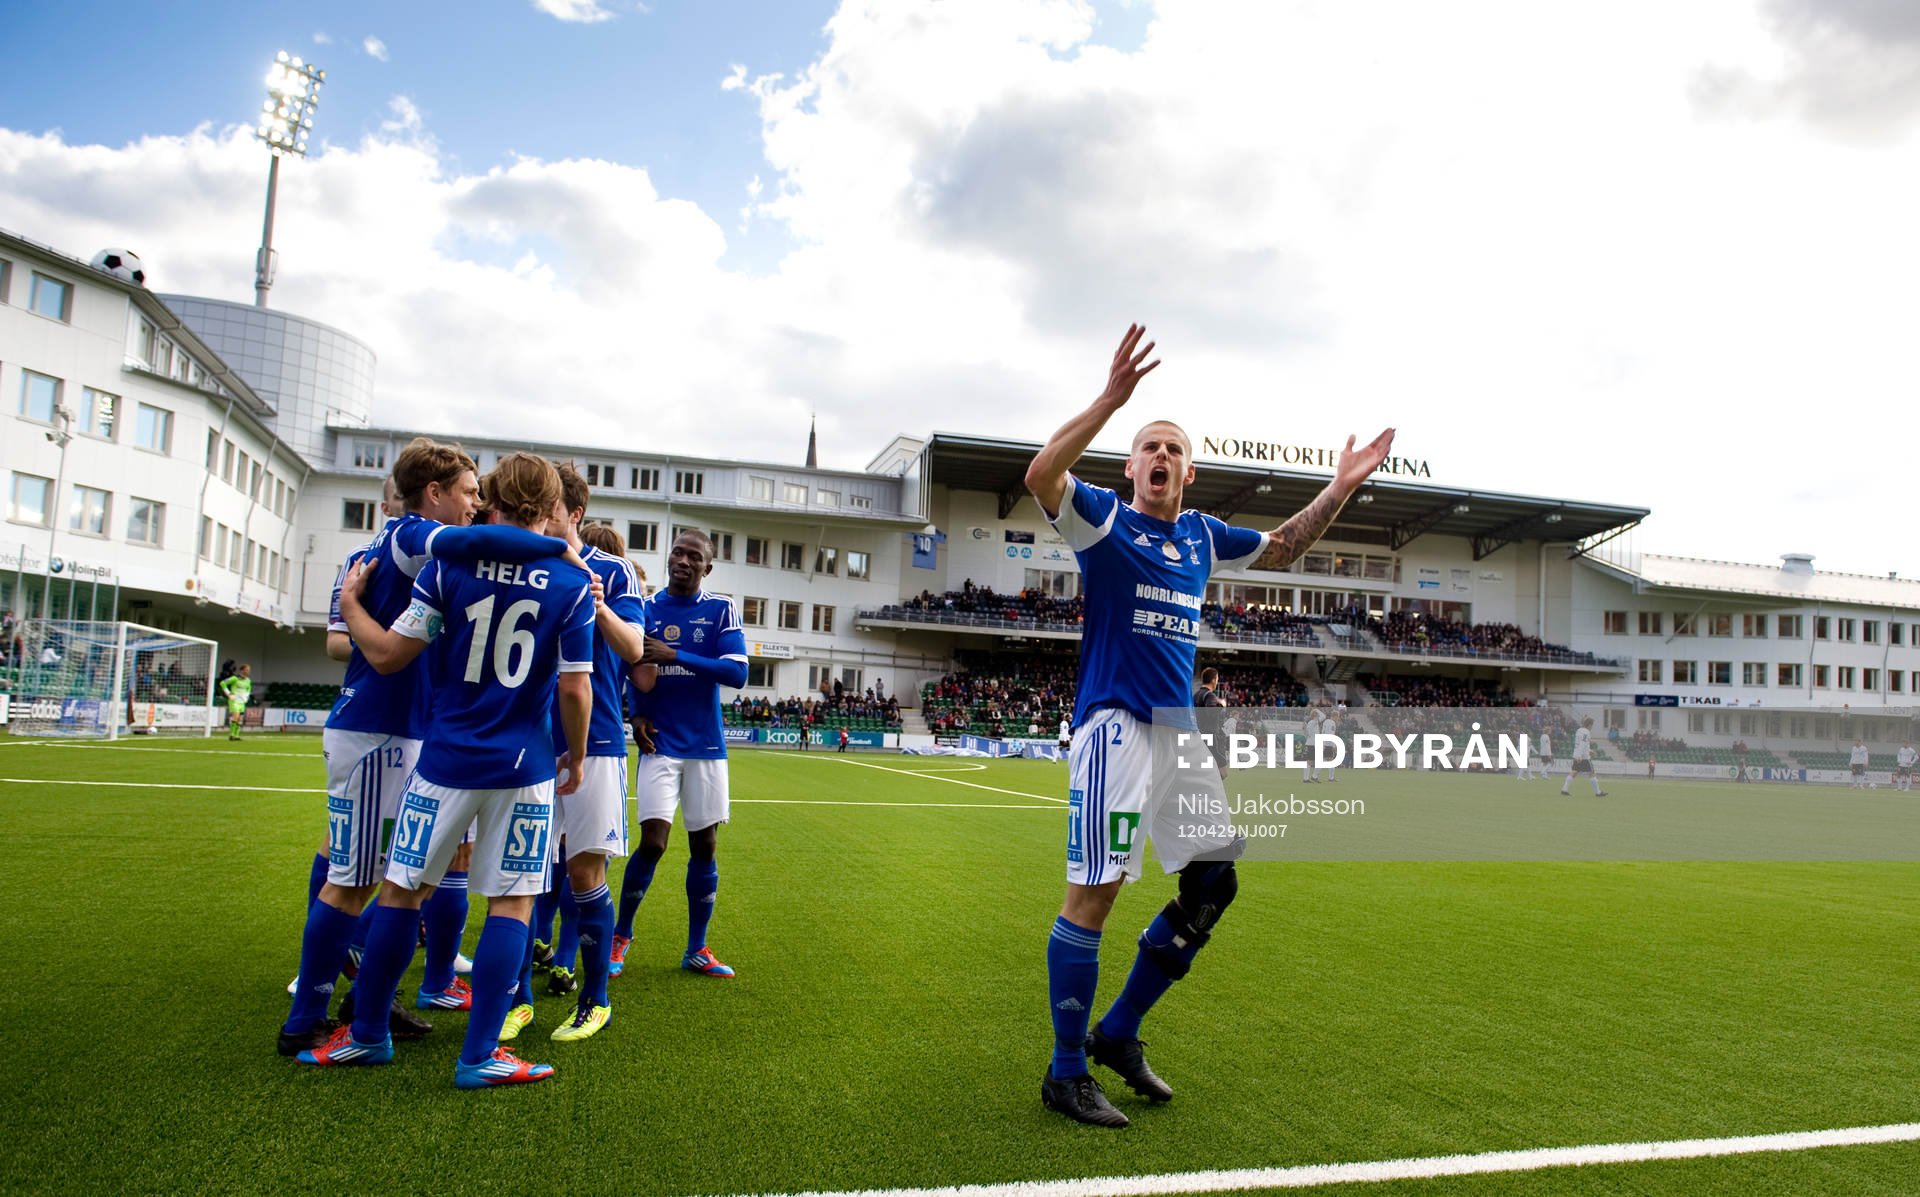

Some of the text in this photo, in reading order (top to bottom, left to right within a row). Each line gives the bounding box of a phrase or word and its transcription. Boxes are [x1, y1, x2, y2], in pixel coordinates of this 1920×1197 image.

[1203, 436, 1431, 478] NORRPORTE RENA
[475, 560, 550, 590] HELG
[463, 594, 541, 689] 16
[1111, 723, 1122, 745] 2
[385, 747, 403, 768] 12
[1771, 769, 1800, 780] NVS
[397, 808, 433, 852] ST
[507, 818, 547, 858] ST
